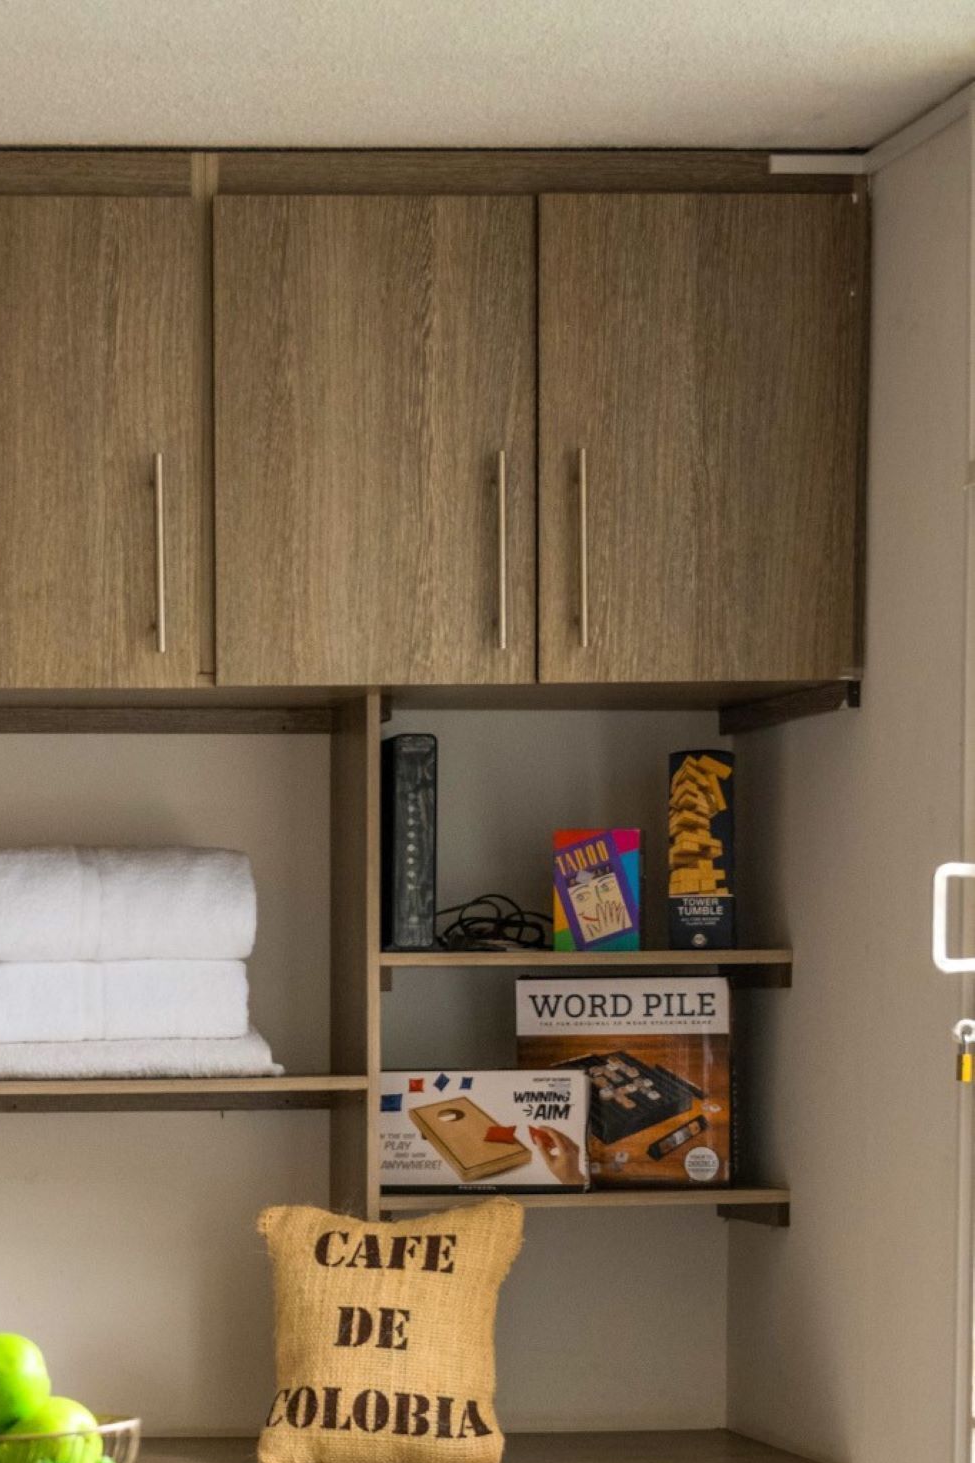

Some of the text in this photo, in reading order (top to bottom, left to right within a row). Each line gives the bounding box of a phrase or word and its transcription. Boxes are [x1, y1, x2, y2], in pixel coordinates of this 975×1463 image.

[555, 840, 609, 876] TABOO
[682, 897, 719, 906] TOWER
[677, 906, 724, 916] TUMBLE
[529, 992, 716, 1018] WORD PILE
[513, 1091, 571, 1103] WINNING
[533, 1104, 571, 1120] AIM
[384, 1141, 412, 1150] PLAY
[380, 1160, 443, 1170] ANYWHERE!
[314, 1230, 458, 1274] CAFE
[334, 1306, 410, 1350] DE
